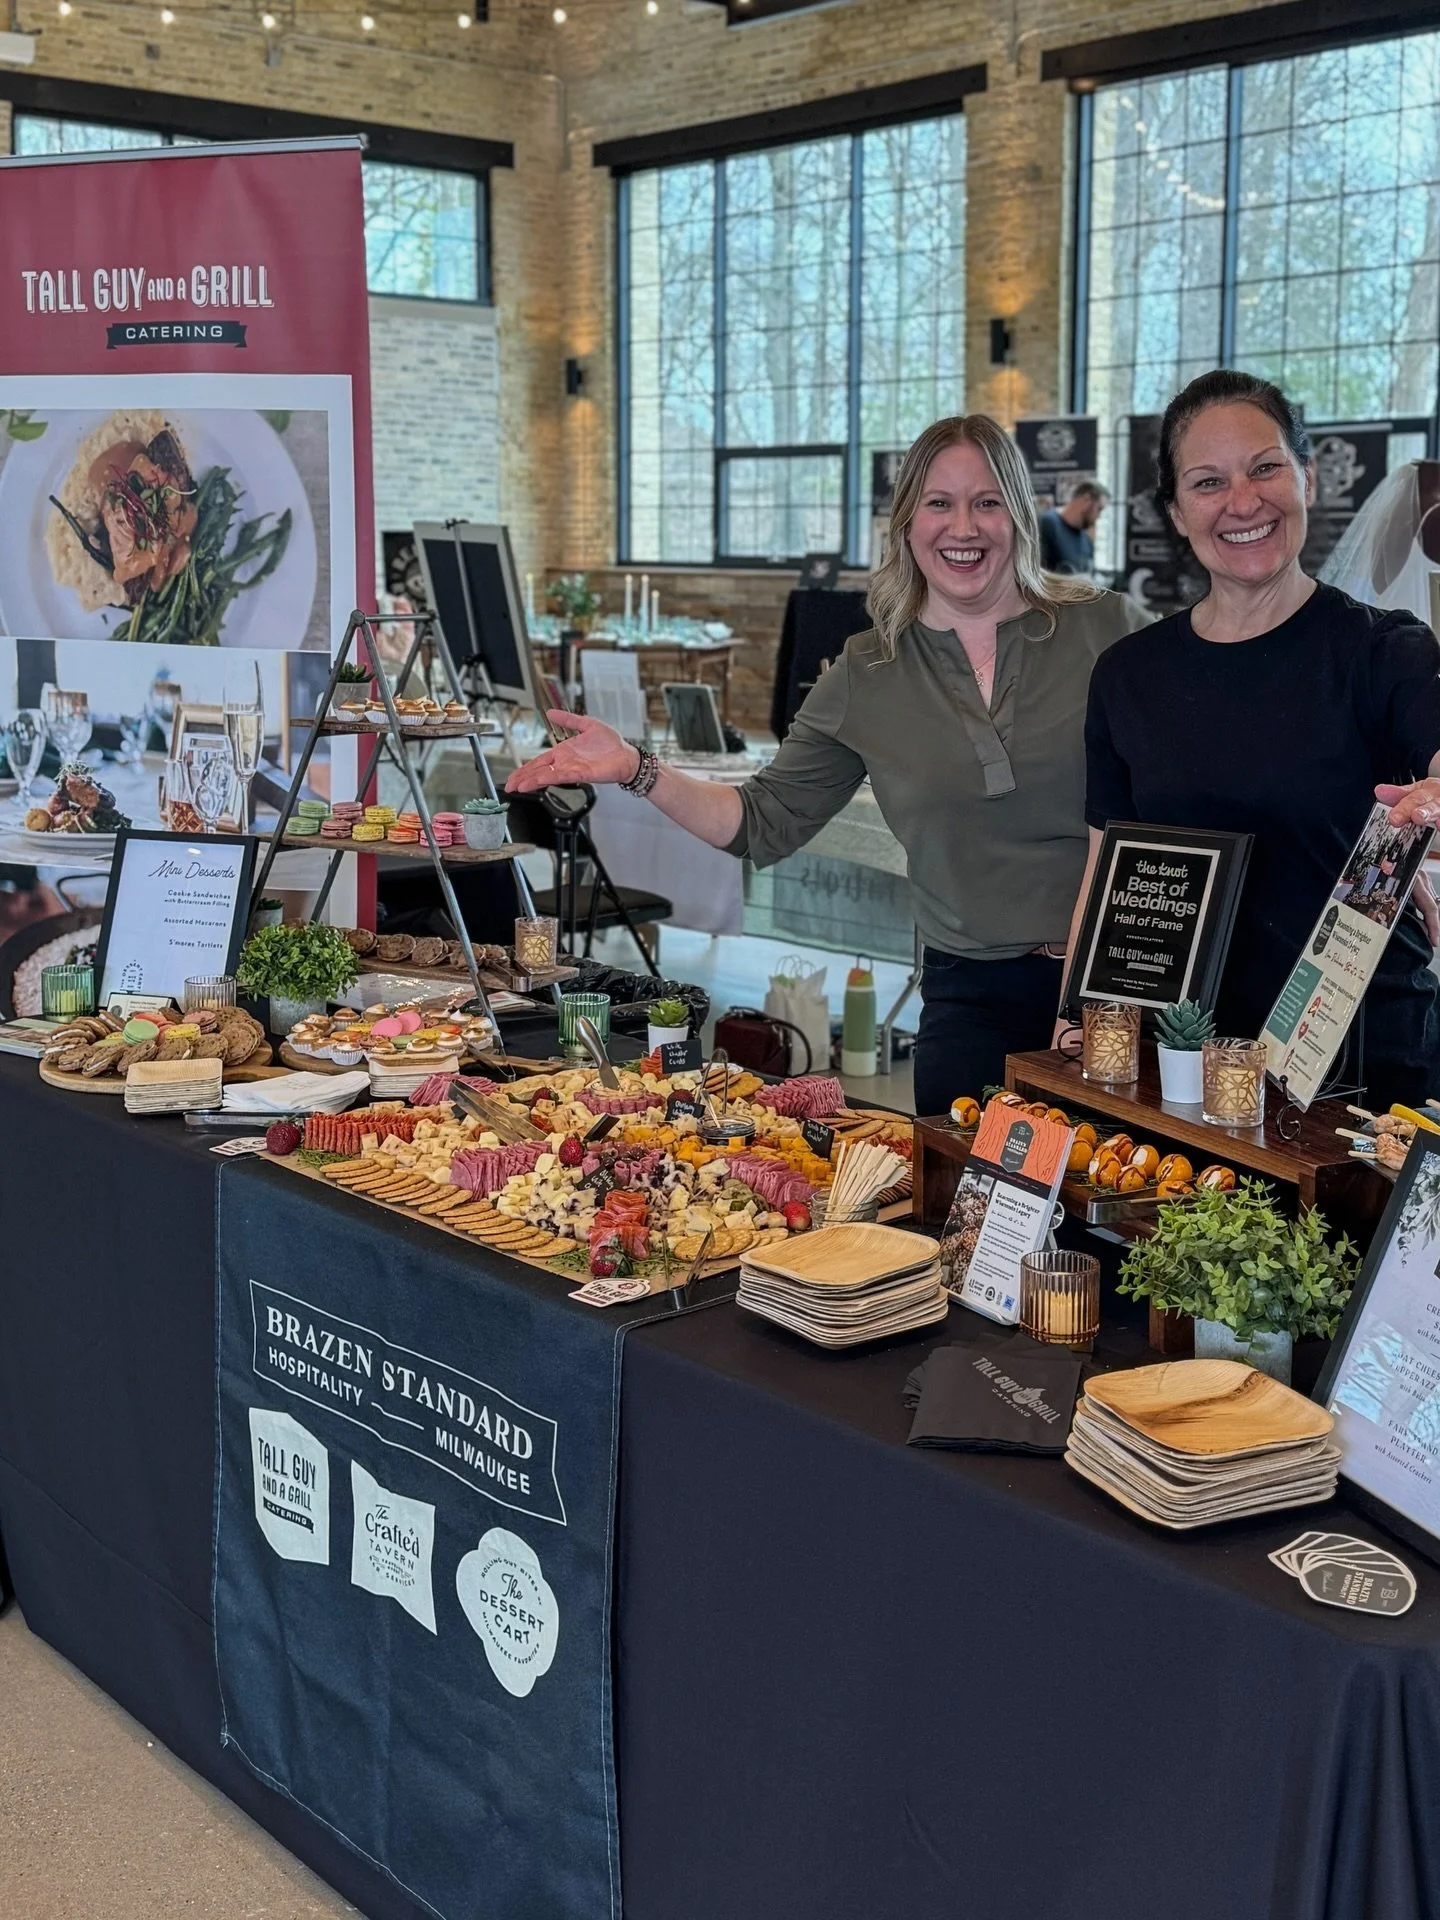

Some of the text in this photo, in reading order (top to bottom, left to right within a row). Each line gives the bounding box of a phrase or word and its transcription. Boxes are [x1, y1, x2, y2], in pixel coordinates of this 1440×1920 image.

[22, 265, 275, 313] TALL GUY AND A GRILL
[126, 325, 224, 340] CATERING
[148, 859, 237, 880] Mini Desserts
[1135, 860, 1189, 878] the knot
[168, 889, 231, 900] Cookie Sandwiches
[1126, 876, 1190, 897] Best of
[1112, 889, 1198, 918] Weddings
[164, 917, 194, 925] Assorted
[1114, 912, 1184, 931] Hall of Fame
[1108, 945, 1125, 959] TALL
[1126, 948, 1143, 961] GUY
[1153, 952, 1174, 966] GRILL
[266, 1305, 533, 1460] BRAZEN STANDARD
[972, 1356, 1001, 1380] TALL
[994, 1375, 1024, 1395] GUY
[1027, 1397, 1062, 1425] GRILL
[991, 1387, 1033, 1418] CATERING
[268, 1346, 531, 1495] HOSPITALITY MILWAUKEE
[258, 1437, 316, 1491] TALL GUY
[1390, 1435, 1427, 1464] PLATTER
[262, 1473, 312, 1511] AND A GRILL
[266, 1501, 308, 1526] CATERING
[375, 1503, 391, 1520] The
[365, 1512, 420, 1559] Crafted
[369, 1538, 415, 1571] TAVERN
[501, 1572, 524, 1600] The
[1346, 1570, 1365, 1605] STANDARD
[1358, 1576, 1375, 1604] BRAZEN
[479, 1589, 545, 1633] DESSERT
[482, 1611, 512, 1660] MILWAUKEE
[494, 1613, 530, 1645] CART
